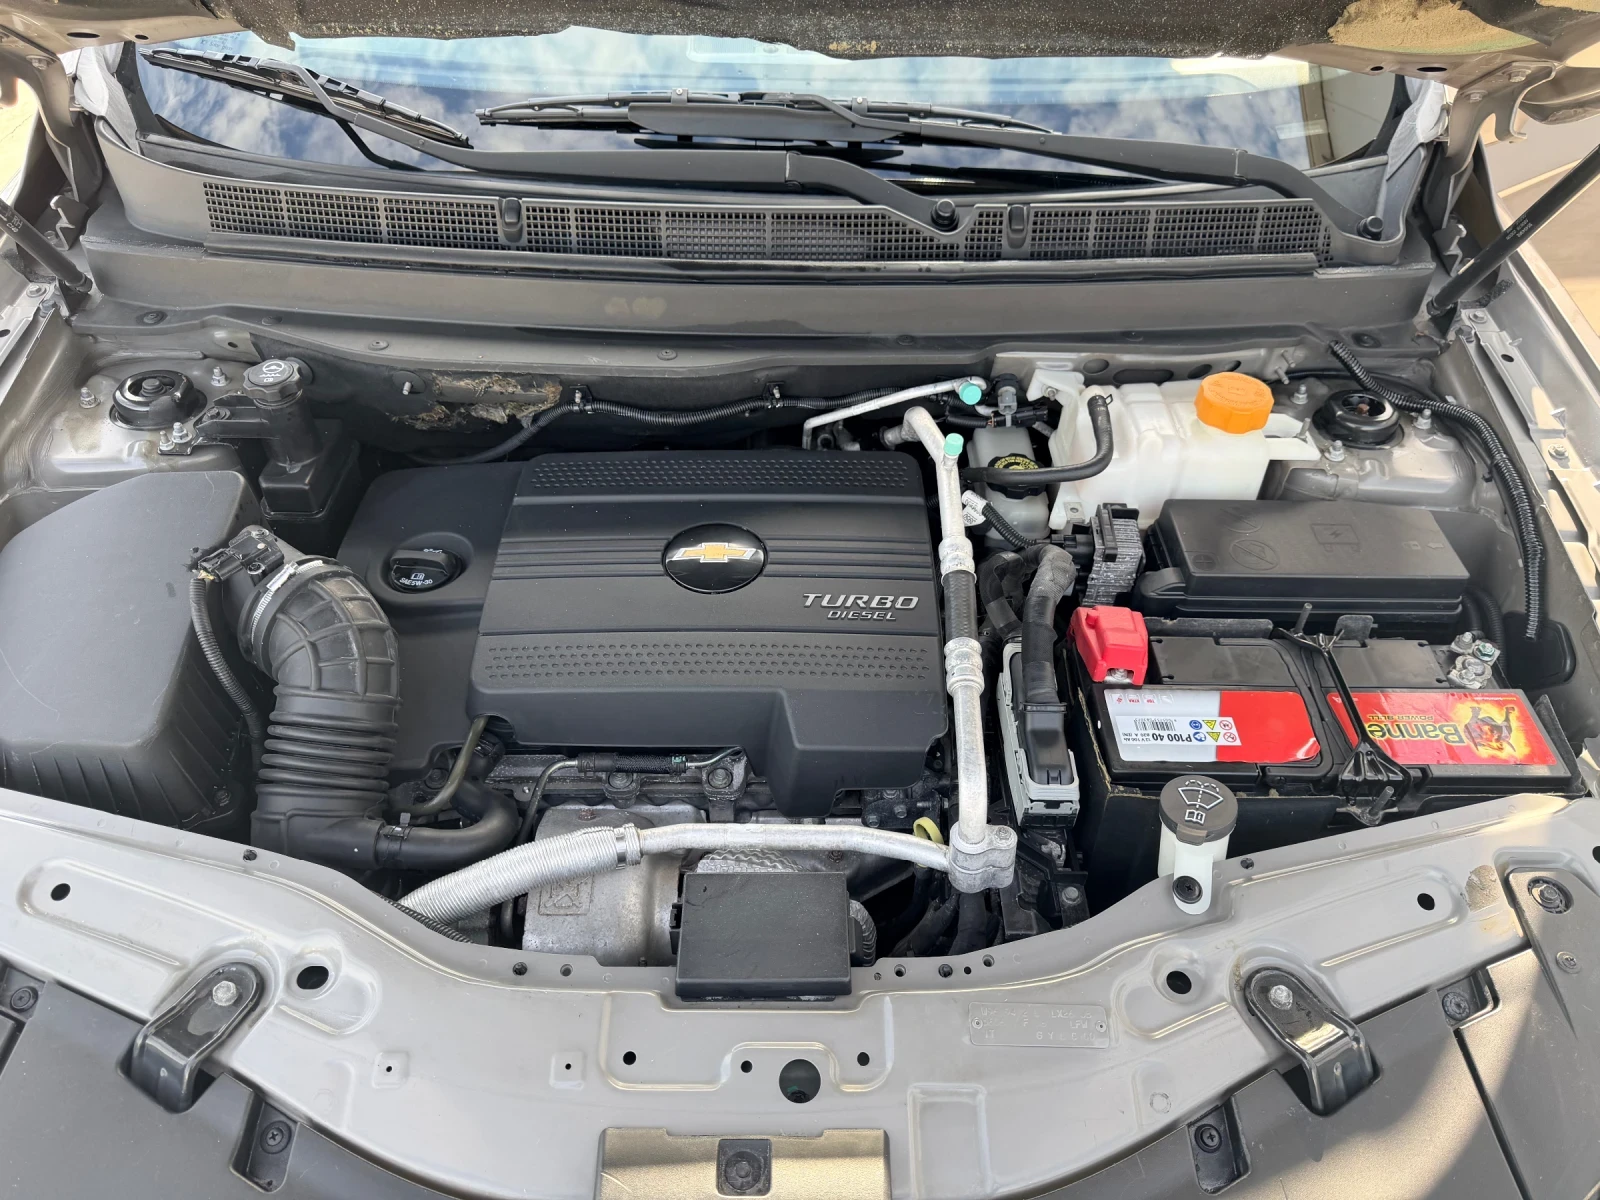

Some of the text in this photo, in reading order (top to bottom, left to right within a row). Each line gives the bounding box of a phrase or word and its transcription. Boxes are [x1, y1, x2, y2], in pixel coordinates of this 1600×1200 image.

[803, 593, 920, 609] TURBO
[827, 610, 897, 621] DIESEL
[1151, 732, 1192, 742] P100 40
[1367, 723, 1465, 744] Banne
